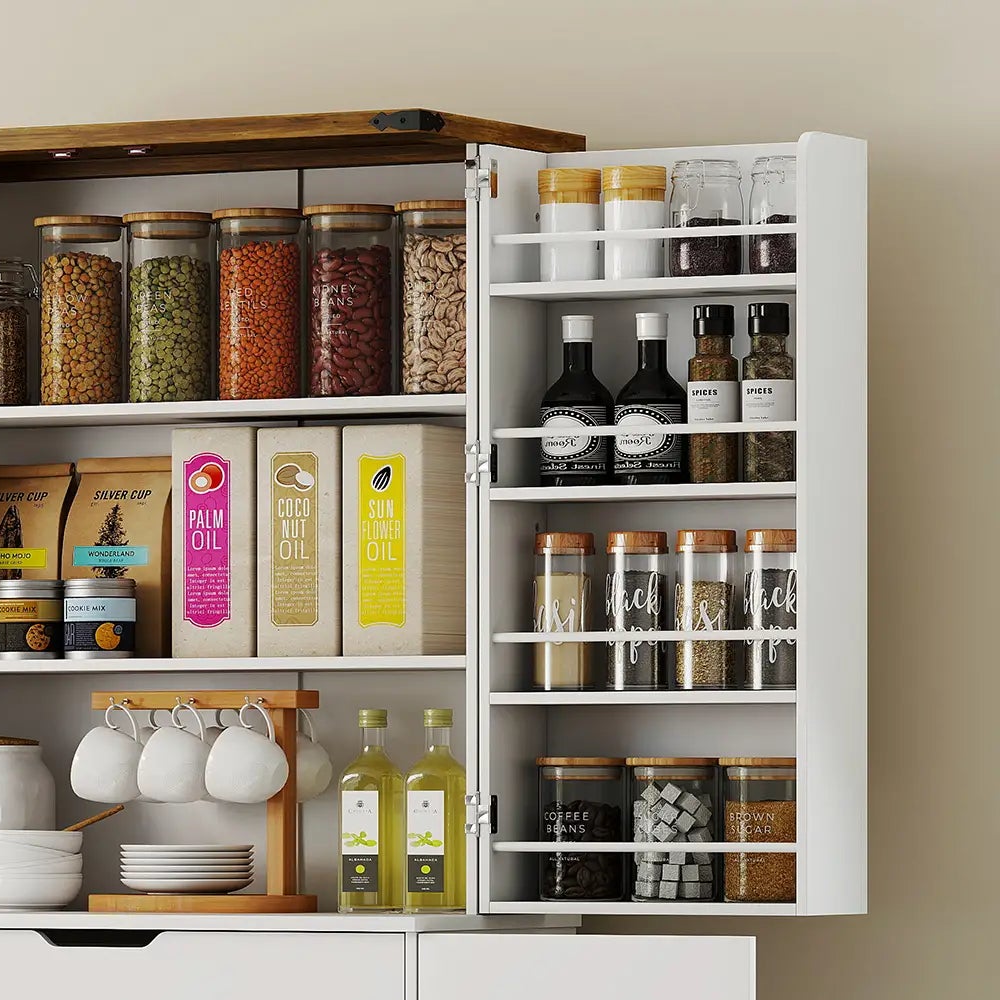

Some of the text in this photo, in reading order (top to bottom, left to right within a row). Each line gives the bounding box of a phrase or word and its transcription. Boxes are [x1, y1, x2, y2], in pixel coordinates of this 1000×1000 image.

[312, 284, 357, 295] KIDNEY
[220, 300, 268, 311] LETILS
[314, 296, 354, 307] BEANS
[691, 389, 718, 397] SPICES
[746, 387, 773, 395] SPICES
[26, 491, 49, 502] CUP
[93, 489, 152, 500] SILVER CUP
[278, 497, 310, 518] COCO
[368, 498, 394, 519] SUN
[189, 509, 224, 530] PALM
[282, 519, 307, 539] NUT
[362, 519, 401, 541] FLOWER
[191, 530, 222, 551] OIL
[280, 540, 310, 560] OIL
[366, 541, 398, 562] OIL
[544, 811, 590, 821] COFFEE
[729, 812, 775, 822] BROWN
[546, 824, 586, 834] BEANS
[731, 825, 772, 834] SUGAR
